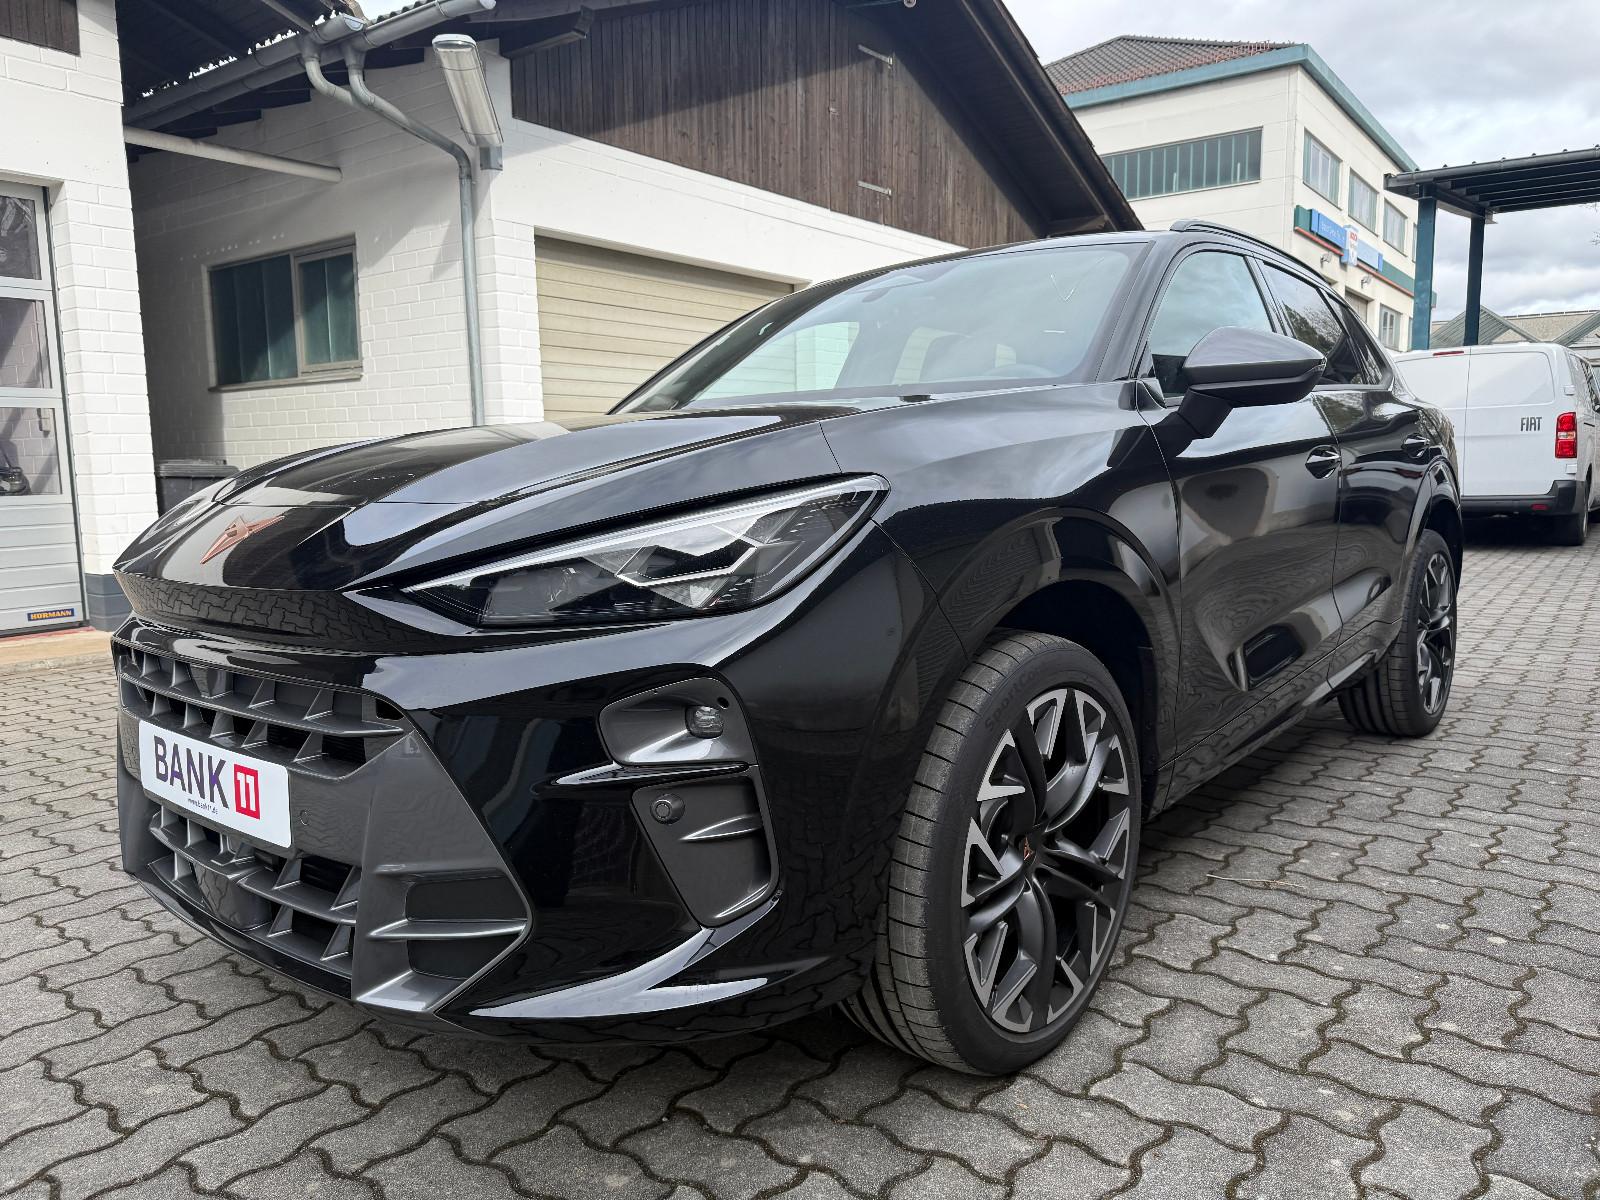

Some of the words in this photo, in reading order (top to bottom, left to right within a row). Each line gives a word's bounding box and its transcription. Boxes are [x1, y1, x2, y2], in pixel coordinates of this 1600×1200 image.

[1520, 416, 1543, 432] FIAT
[153, 735, 230, 809] BANK
[236, 771, 256, 812] 11
